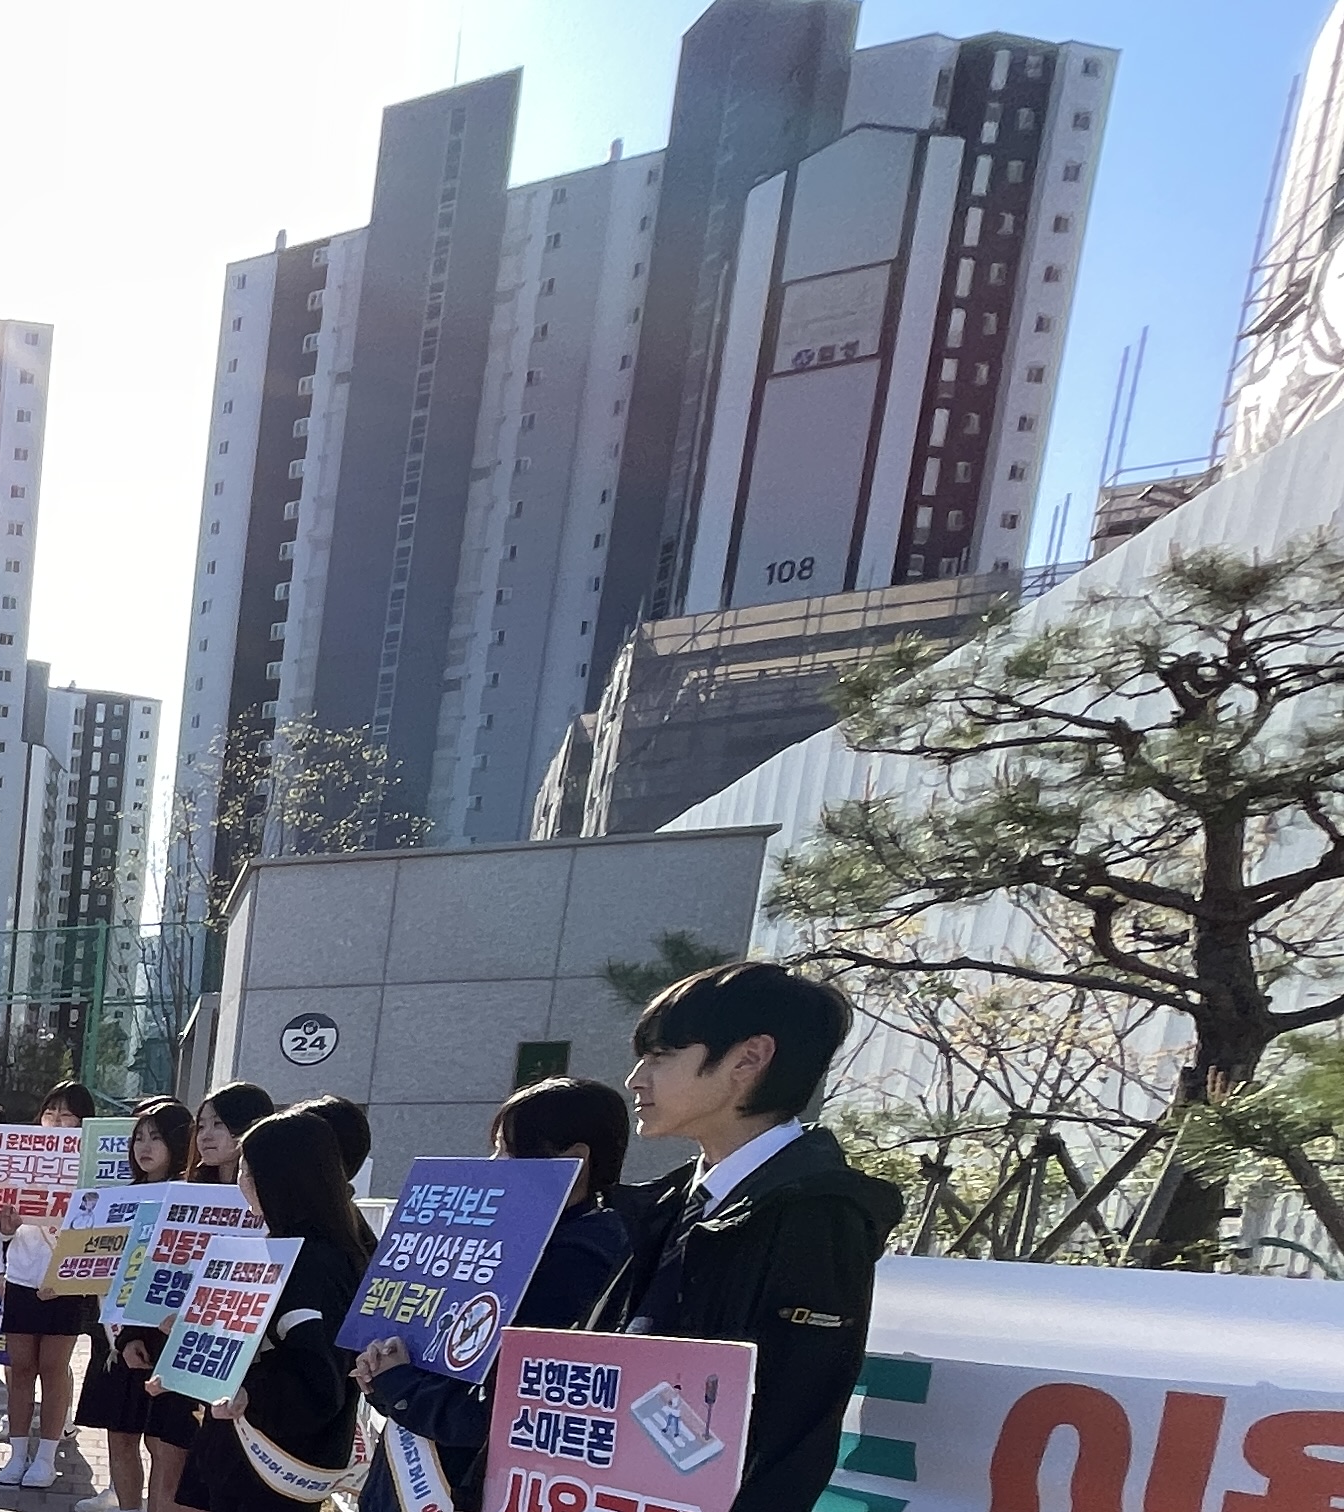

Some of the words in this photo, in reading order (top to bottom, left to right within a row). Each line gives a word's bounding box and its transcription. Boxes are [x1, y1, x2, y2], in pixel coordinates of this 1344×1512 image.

[766, 556, 815, 585] 108
[290, 1036, 327, 1051] 24
[6, 1133, 59, 1152] 운전면허
[400, 1183, 505, 1226] 전동킥보드
[379, 1232, 422, 1272] 2명
[416, 1234, 463, 1278] 이상
[453, 1239, 504, 1284] 탑승
[184, 1286, 271, 1334] 전동킥보드
[359, 1277, 408, 1320] 절대
[395, 1283, 449, 1328] 금지
[172, 1331, 245, 1381] 운행금지
[520, 1360, 619, 1410] 보행중에
[511, 1408, 616, 1466] 스마트폰
